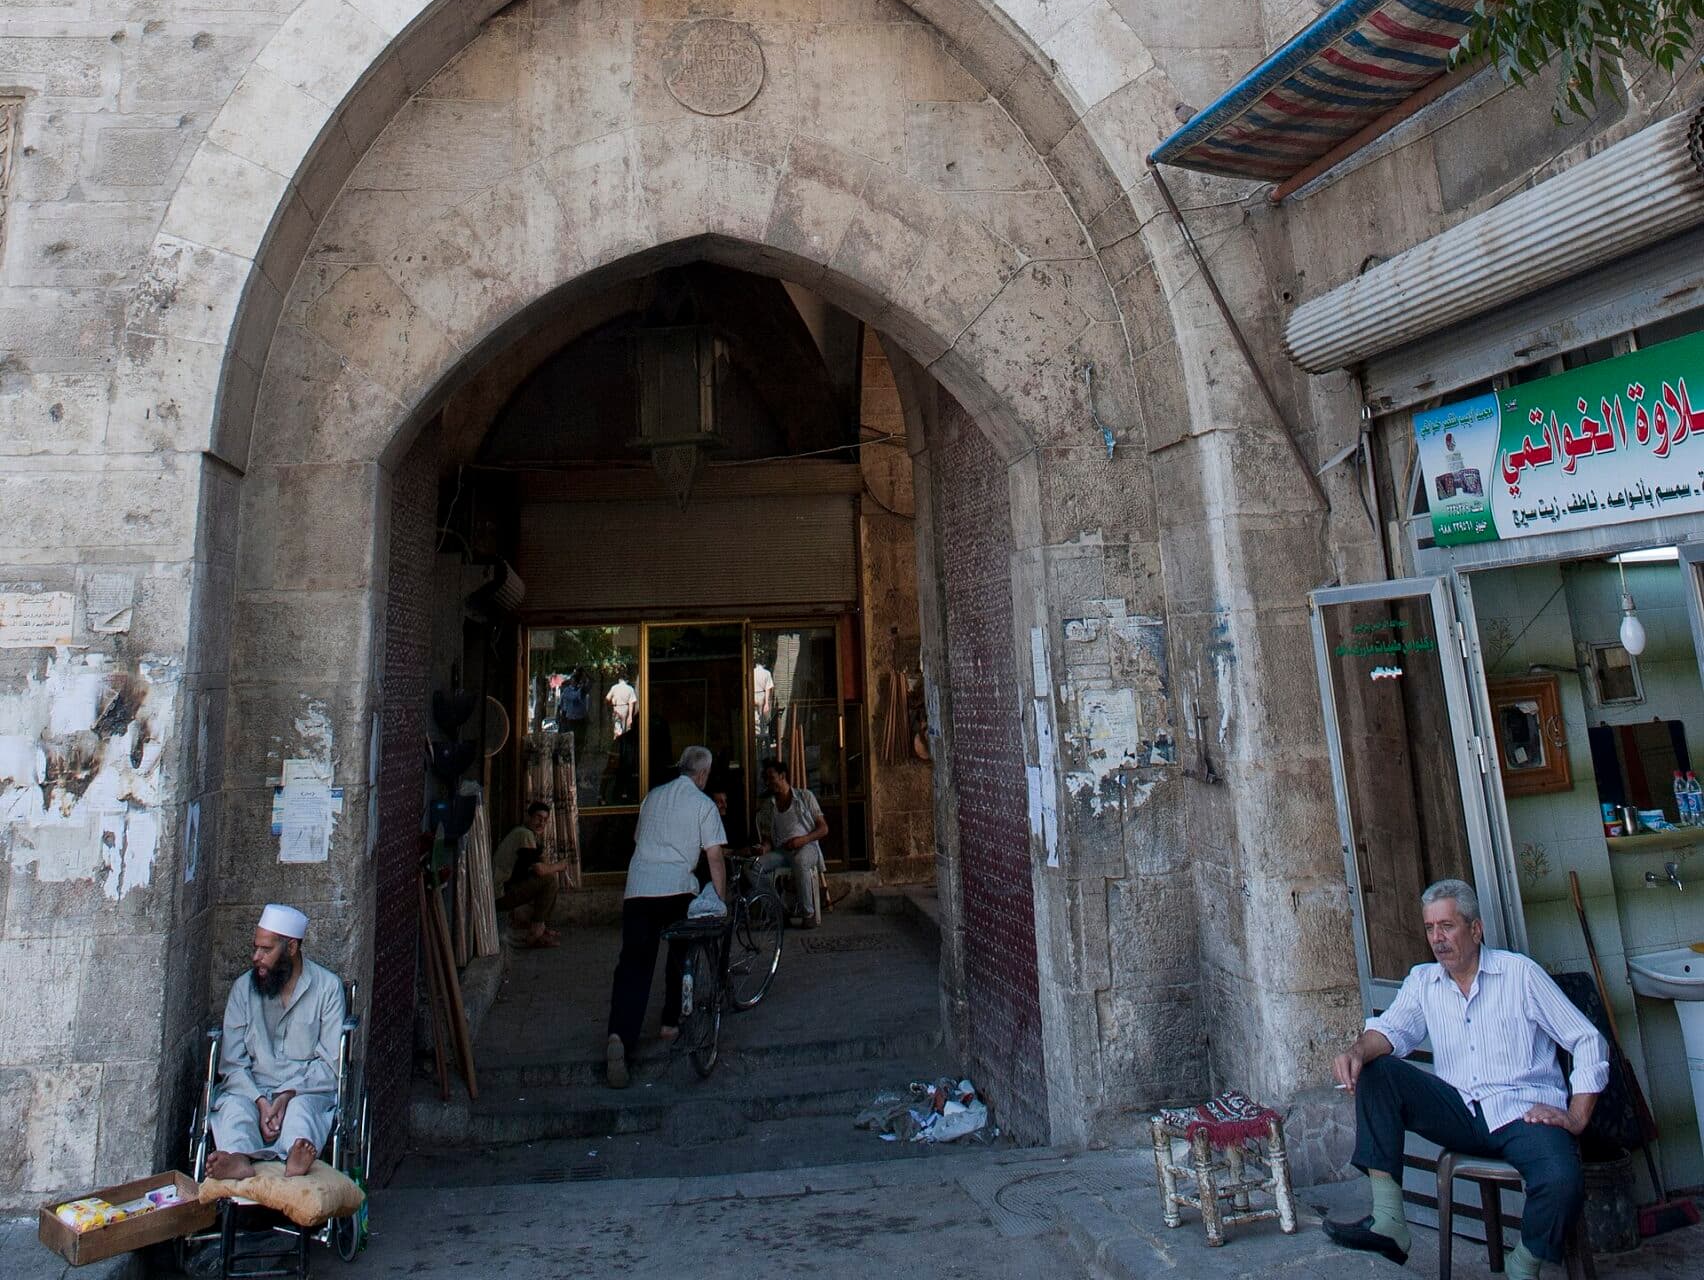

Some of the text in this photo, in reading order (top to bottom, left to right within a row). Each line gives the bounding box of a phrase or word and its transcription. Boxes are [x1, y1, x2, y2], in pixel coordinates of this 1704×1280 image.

[1502, 377, 1704, 496] لاوة الخواتمي
[1566, 489, 1599, 513] ناطف
[1607, 477, 1655, 510] بأنواعه
[1655, 482, 1691, 507] سمسم
[1538, 496, 1561, 523] زيت
